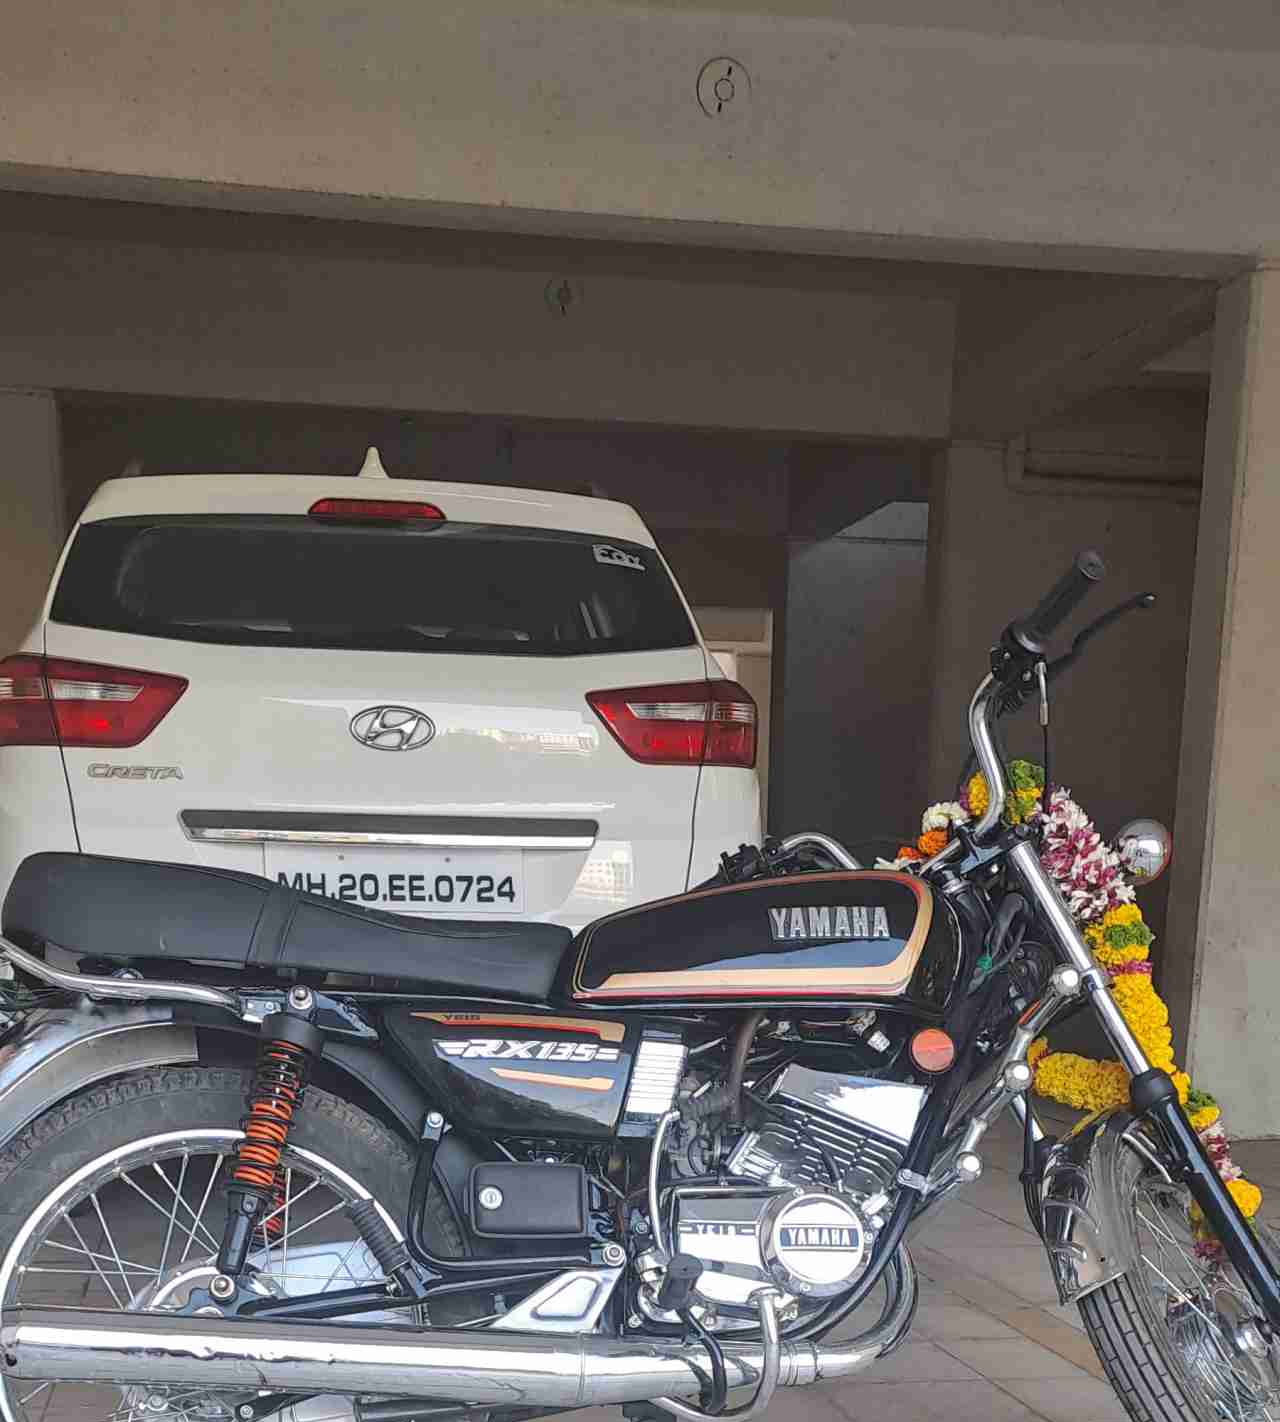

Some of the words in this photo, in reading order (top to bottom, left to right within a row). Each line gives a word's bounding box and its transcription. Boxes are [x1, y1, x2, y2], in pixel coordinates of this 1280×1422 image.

[87, 763, 184, 780] CRETA
[770, 906, 890, 938] YAMAHA
[788, 1228, 851, 1246] YAMAHA
